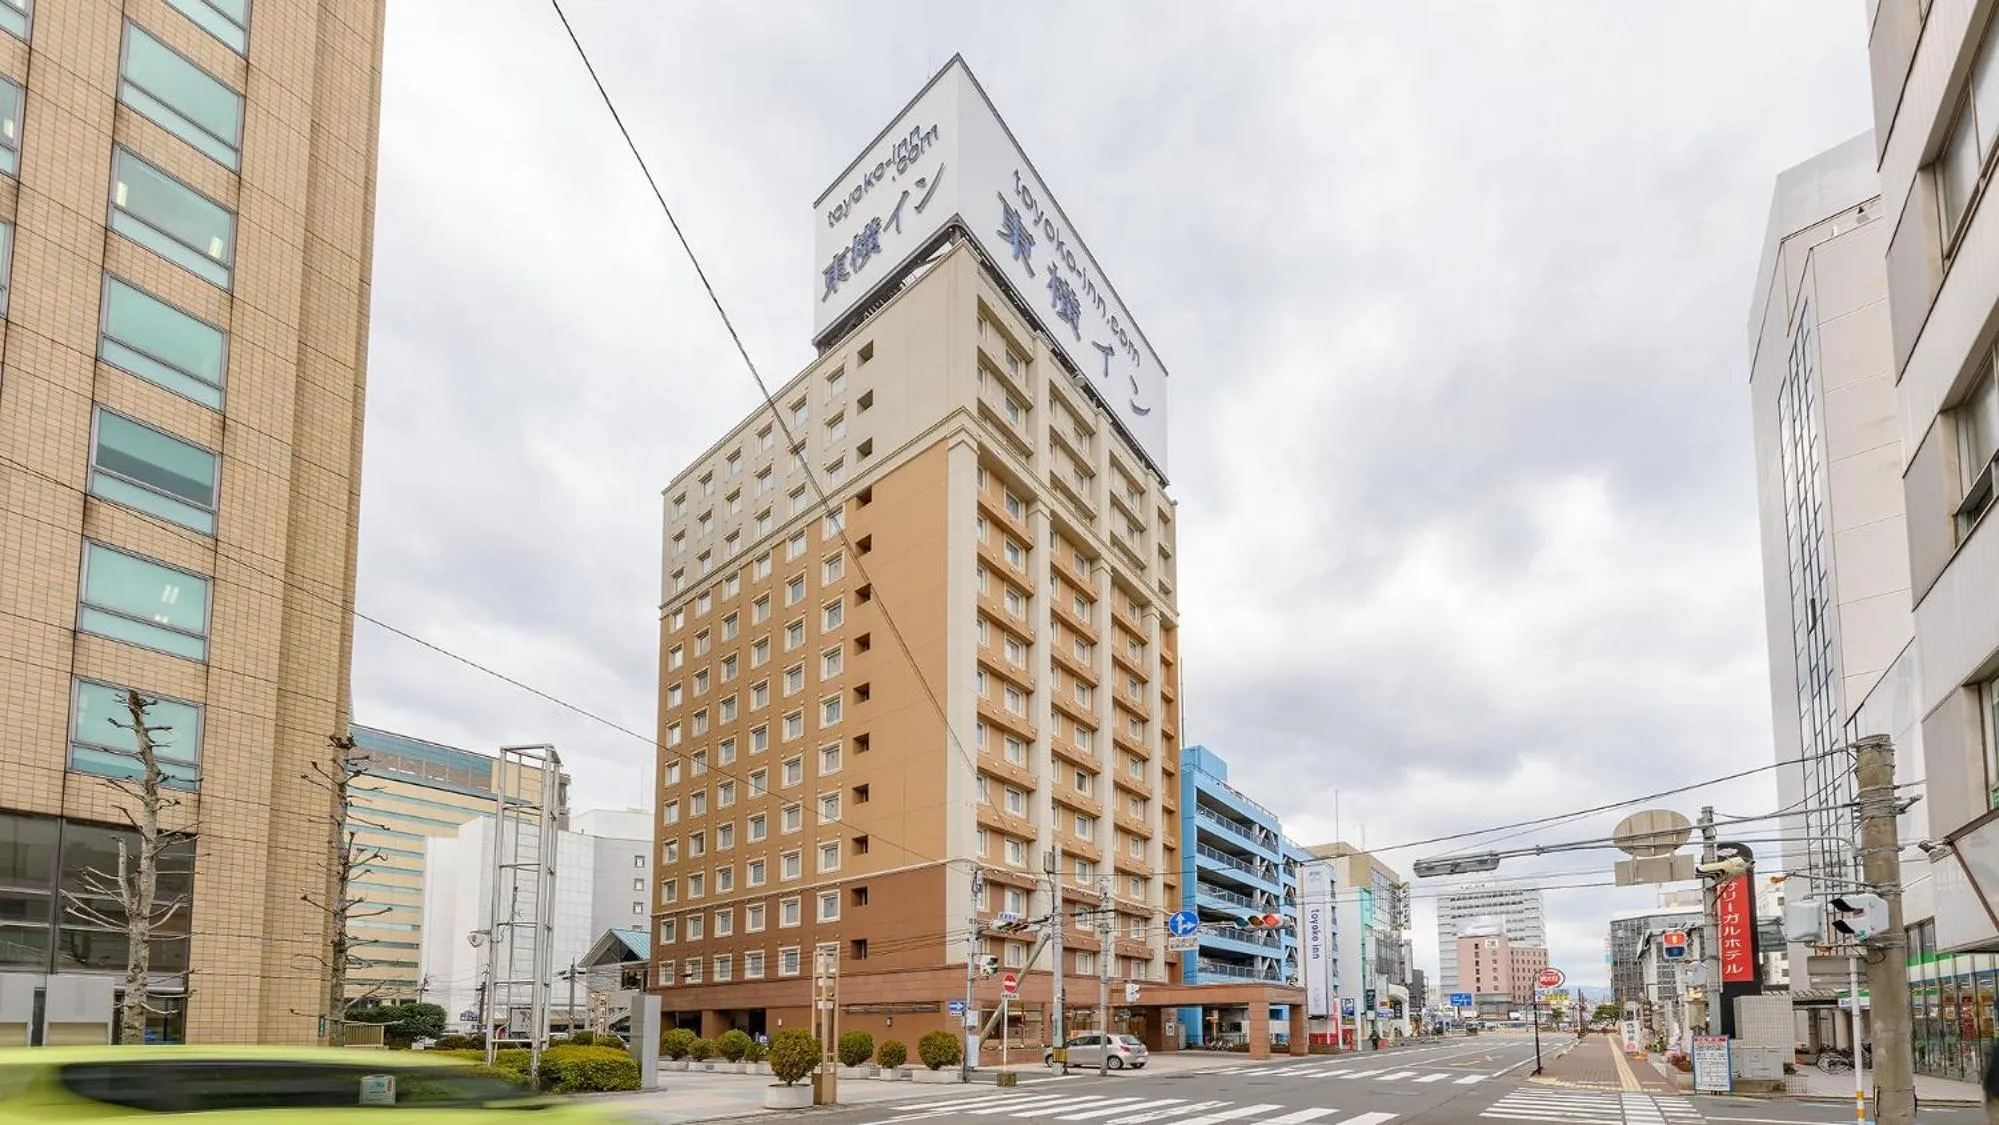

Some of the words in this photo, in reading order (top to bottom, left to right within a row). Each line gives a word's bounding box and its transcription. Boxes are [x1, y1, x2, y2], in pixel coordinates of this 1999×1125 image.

[827, 124, 921, 229] toyoko-inn
[1012, 168, 1141, 368] toyoko-inn.com
[1309, 907, 1321, 942] toyoko
[1311, 943, 1321, 960] inn
